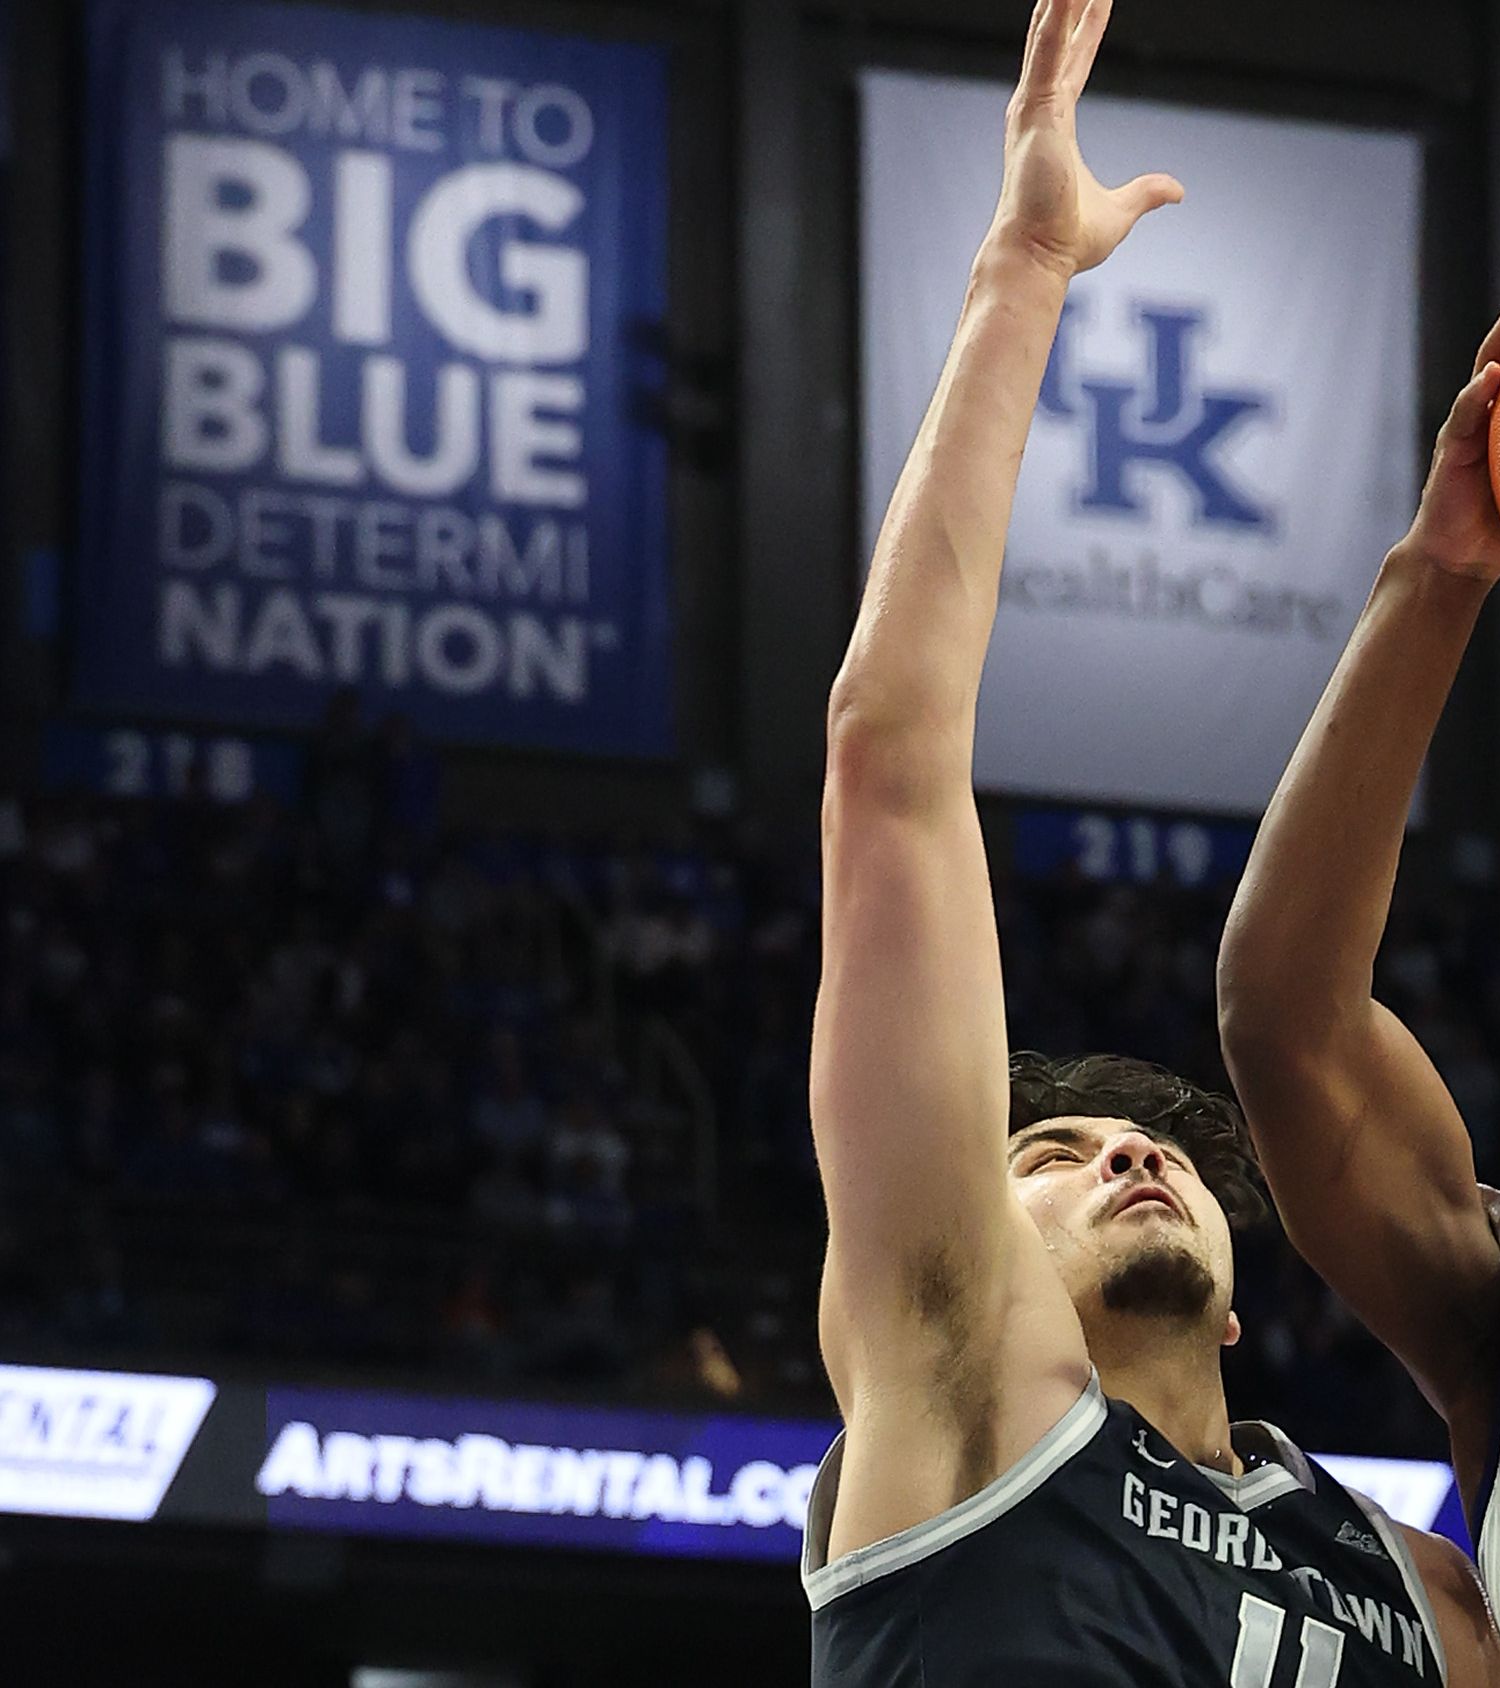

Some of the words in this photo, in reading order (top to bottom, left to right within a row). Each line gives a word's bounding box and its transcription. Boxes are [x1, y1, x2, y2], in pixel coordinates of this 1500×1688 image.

[162, 47, 445, 153] HOME
[463, 78, 594, 167] TO
[162, 134, 591, 367] BIG
[161, 334, 588, 504] BLUE
[160, 484, 591, 603] DETERMI
[998, 549, 1345, 642] ealthCare
[157, 578, 590, 700] NATION
[106, 728, 256, 801] 218
[1073, 813, 1212, 885] 219
